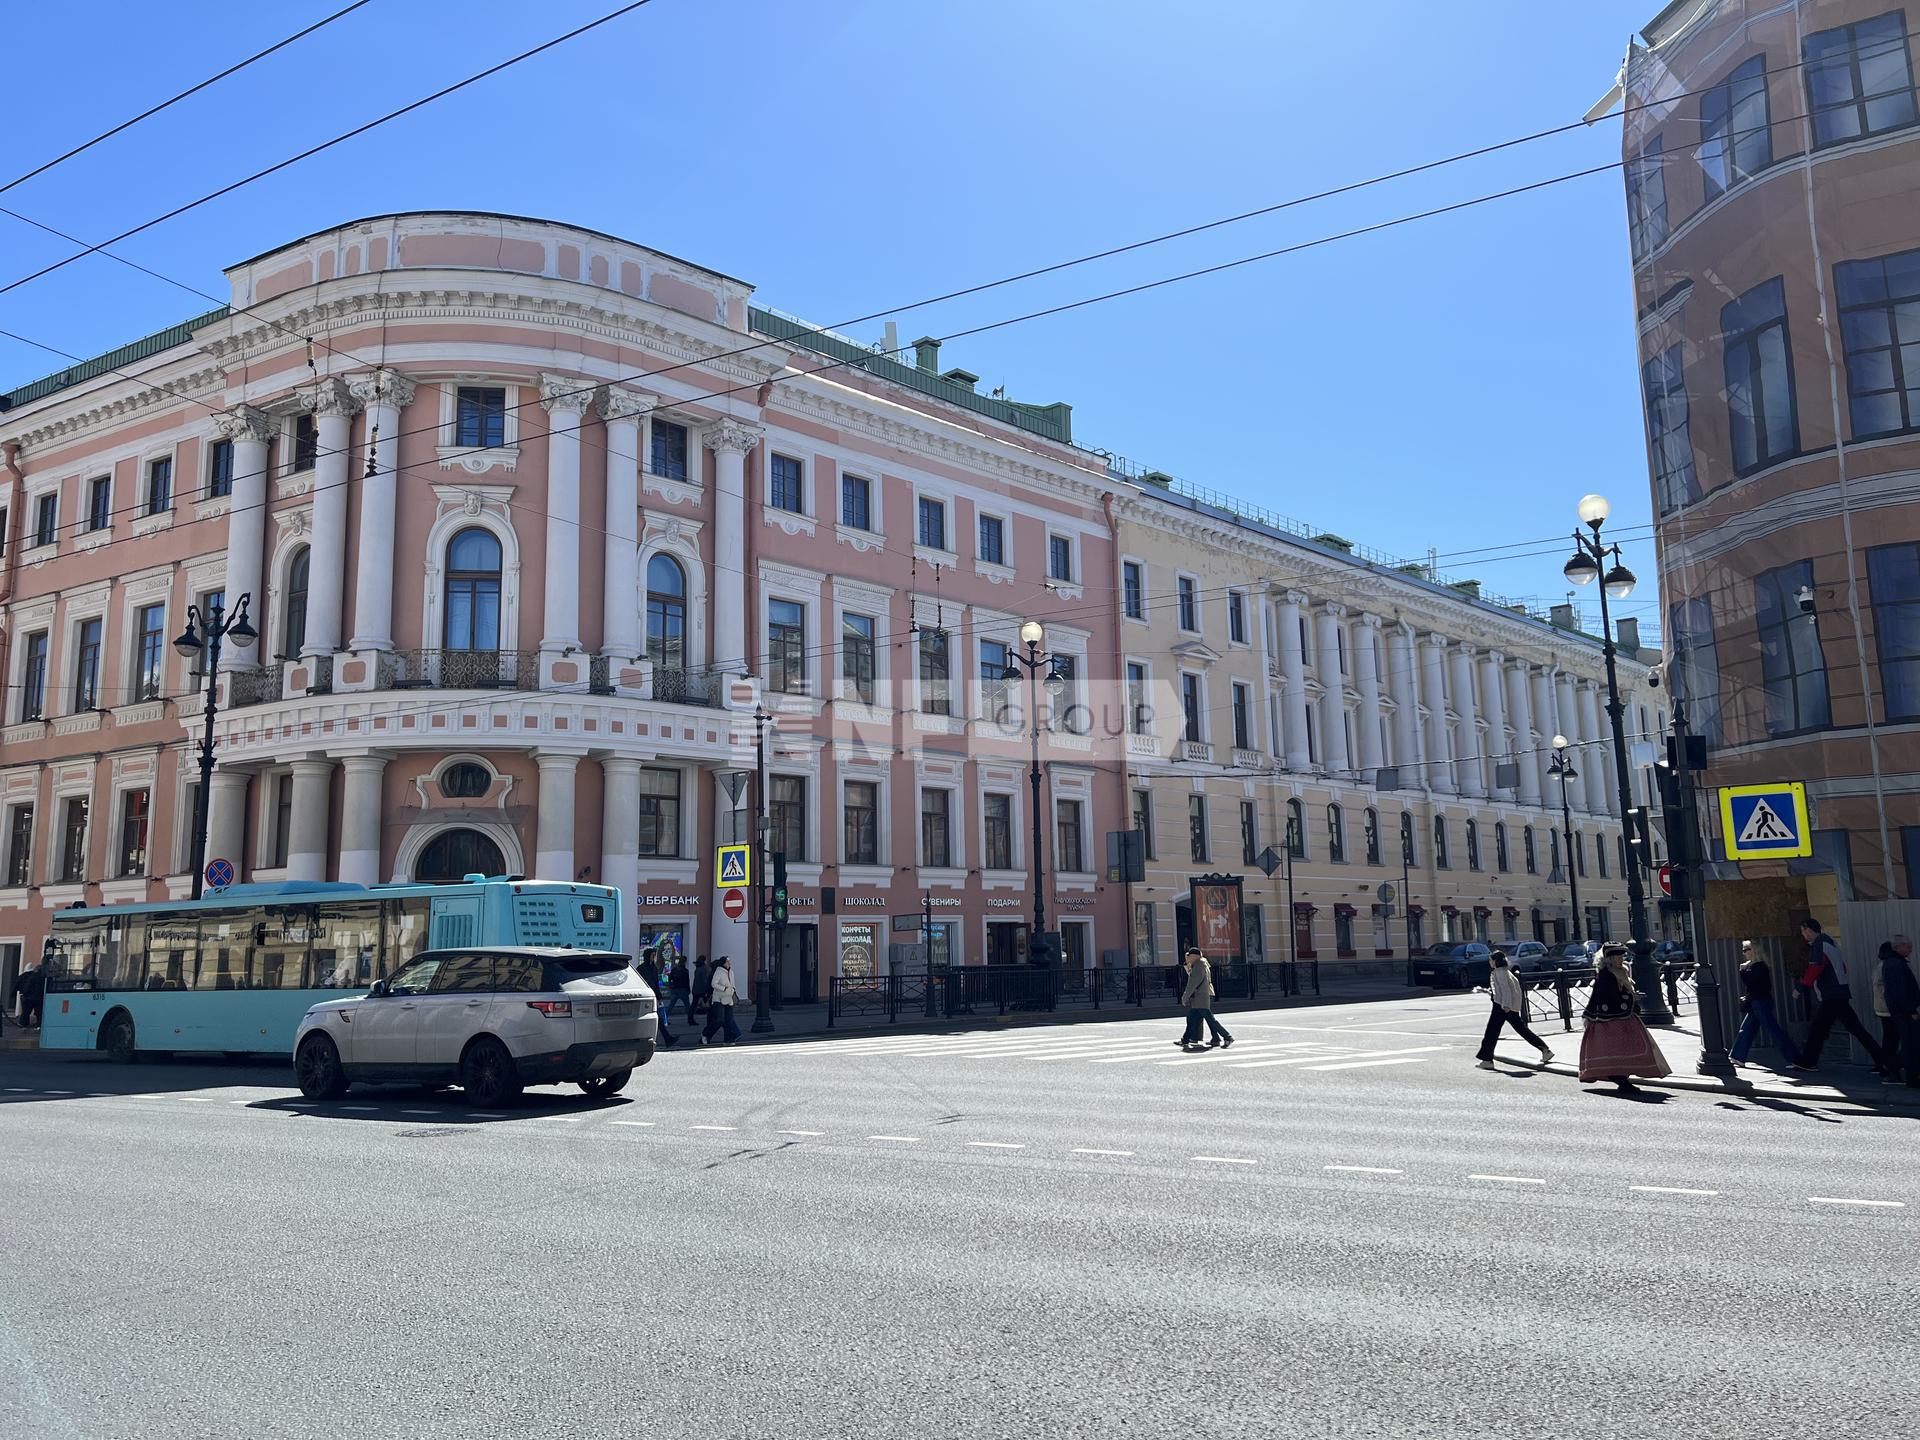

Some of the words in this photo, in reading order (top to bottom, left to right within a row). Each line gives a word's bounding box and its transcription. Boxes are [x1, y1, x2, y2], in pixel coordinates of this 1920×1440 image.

[668, 895, 700, 905] БАНК
[787, 897, 816, 906] ФЕТЫ
[844, 897, 886, 906] ШОКОЛАД
[987, 898, 1021, 907] ПОДАРКИ
[841, 926, 871, 934] КОНФЕТЫ
[841, 935, 872, 944] ШОКОЛАД
